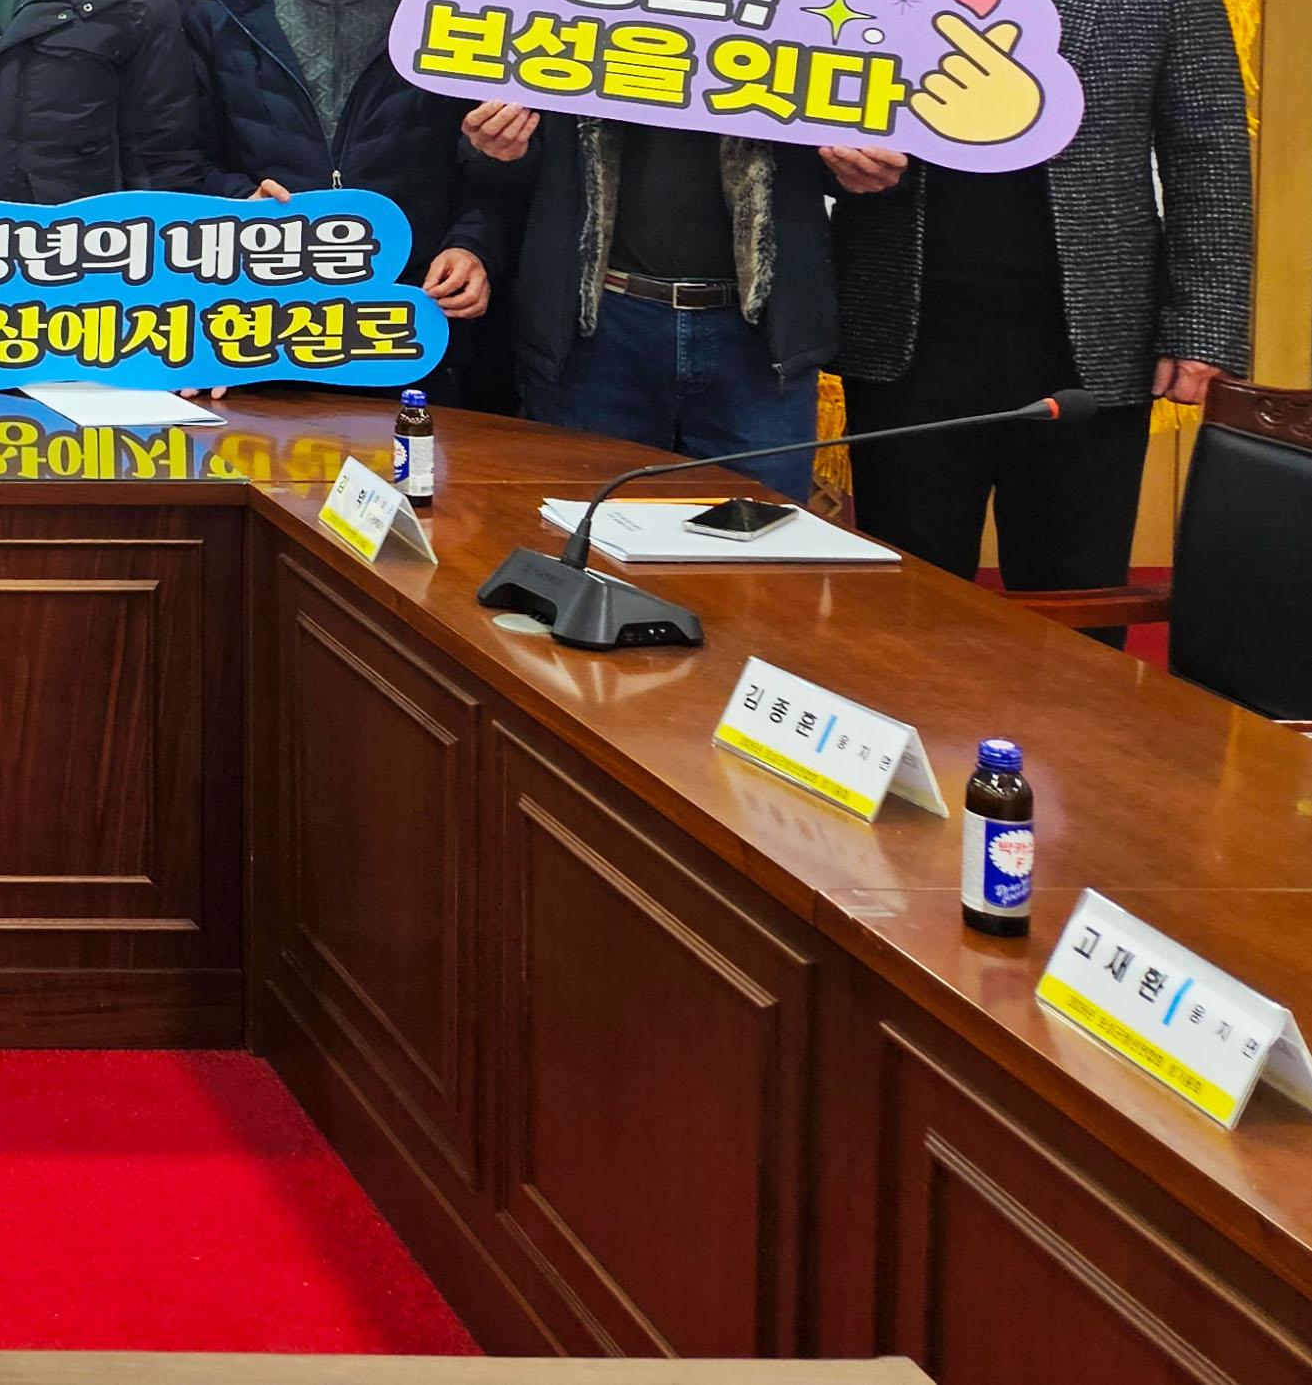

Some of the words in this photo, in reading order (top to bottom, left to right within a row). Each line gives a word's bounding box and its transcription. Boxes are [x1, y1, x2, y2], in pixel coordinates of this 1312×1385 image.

[414, 2, 695, 109] 보성을
[703, 35, 909, 135] 잇다
[159, 215, 378, 283] 내일을
[203, 296, 424, 362] 현실로
